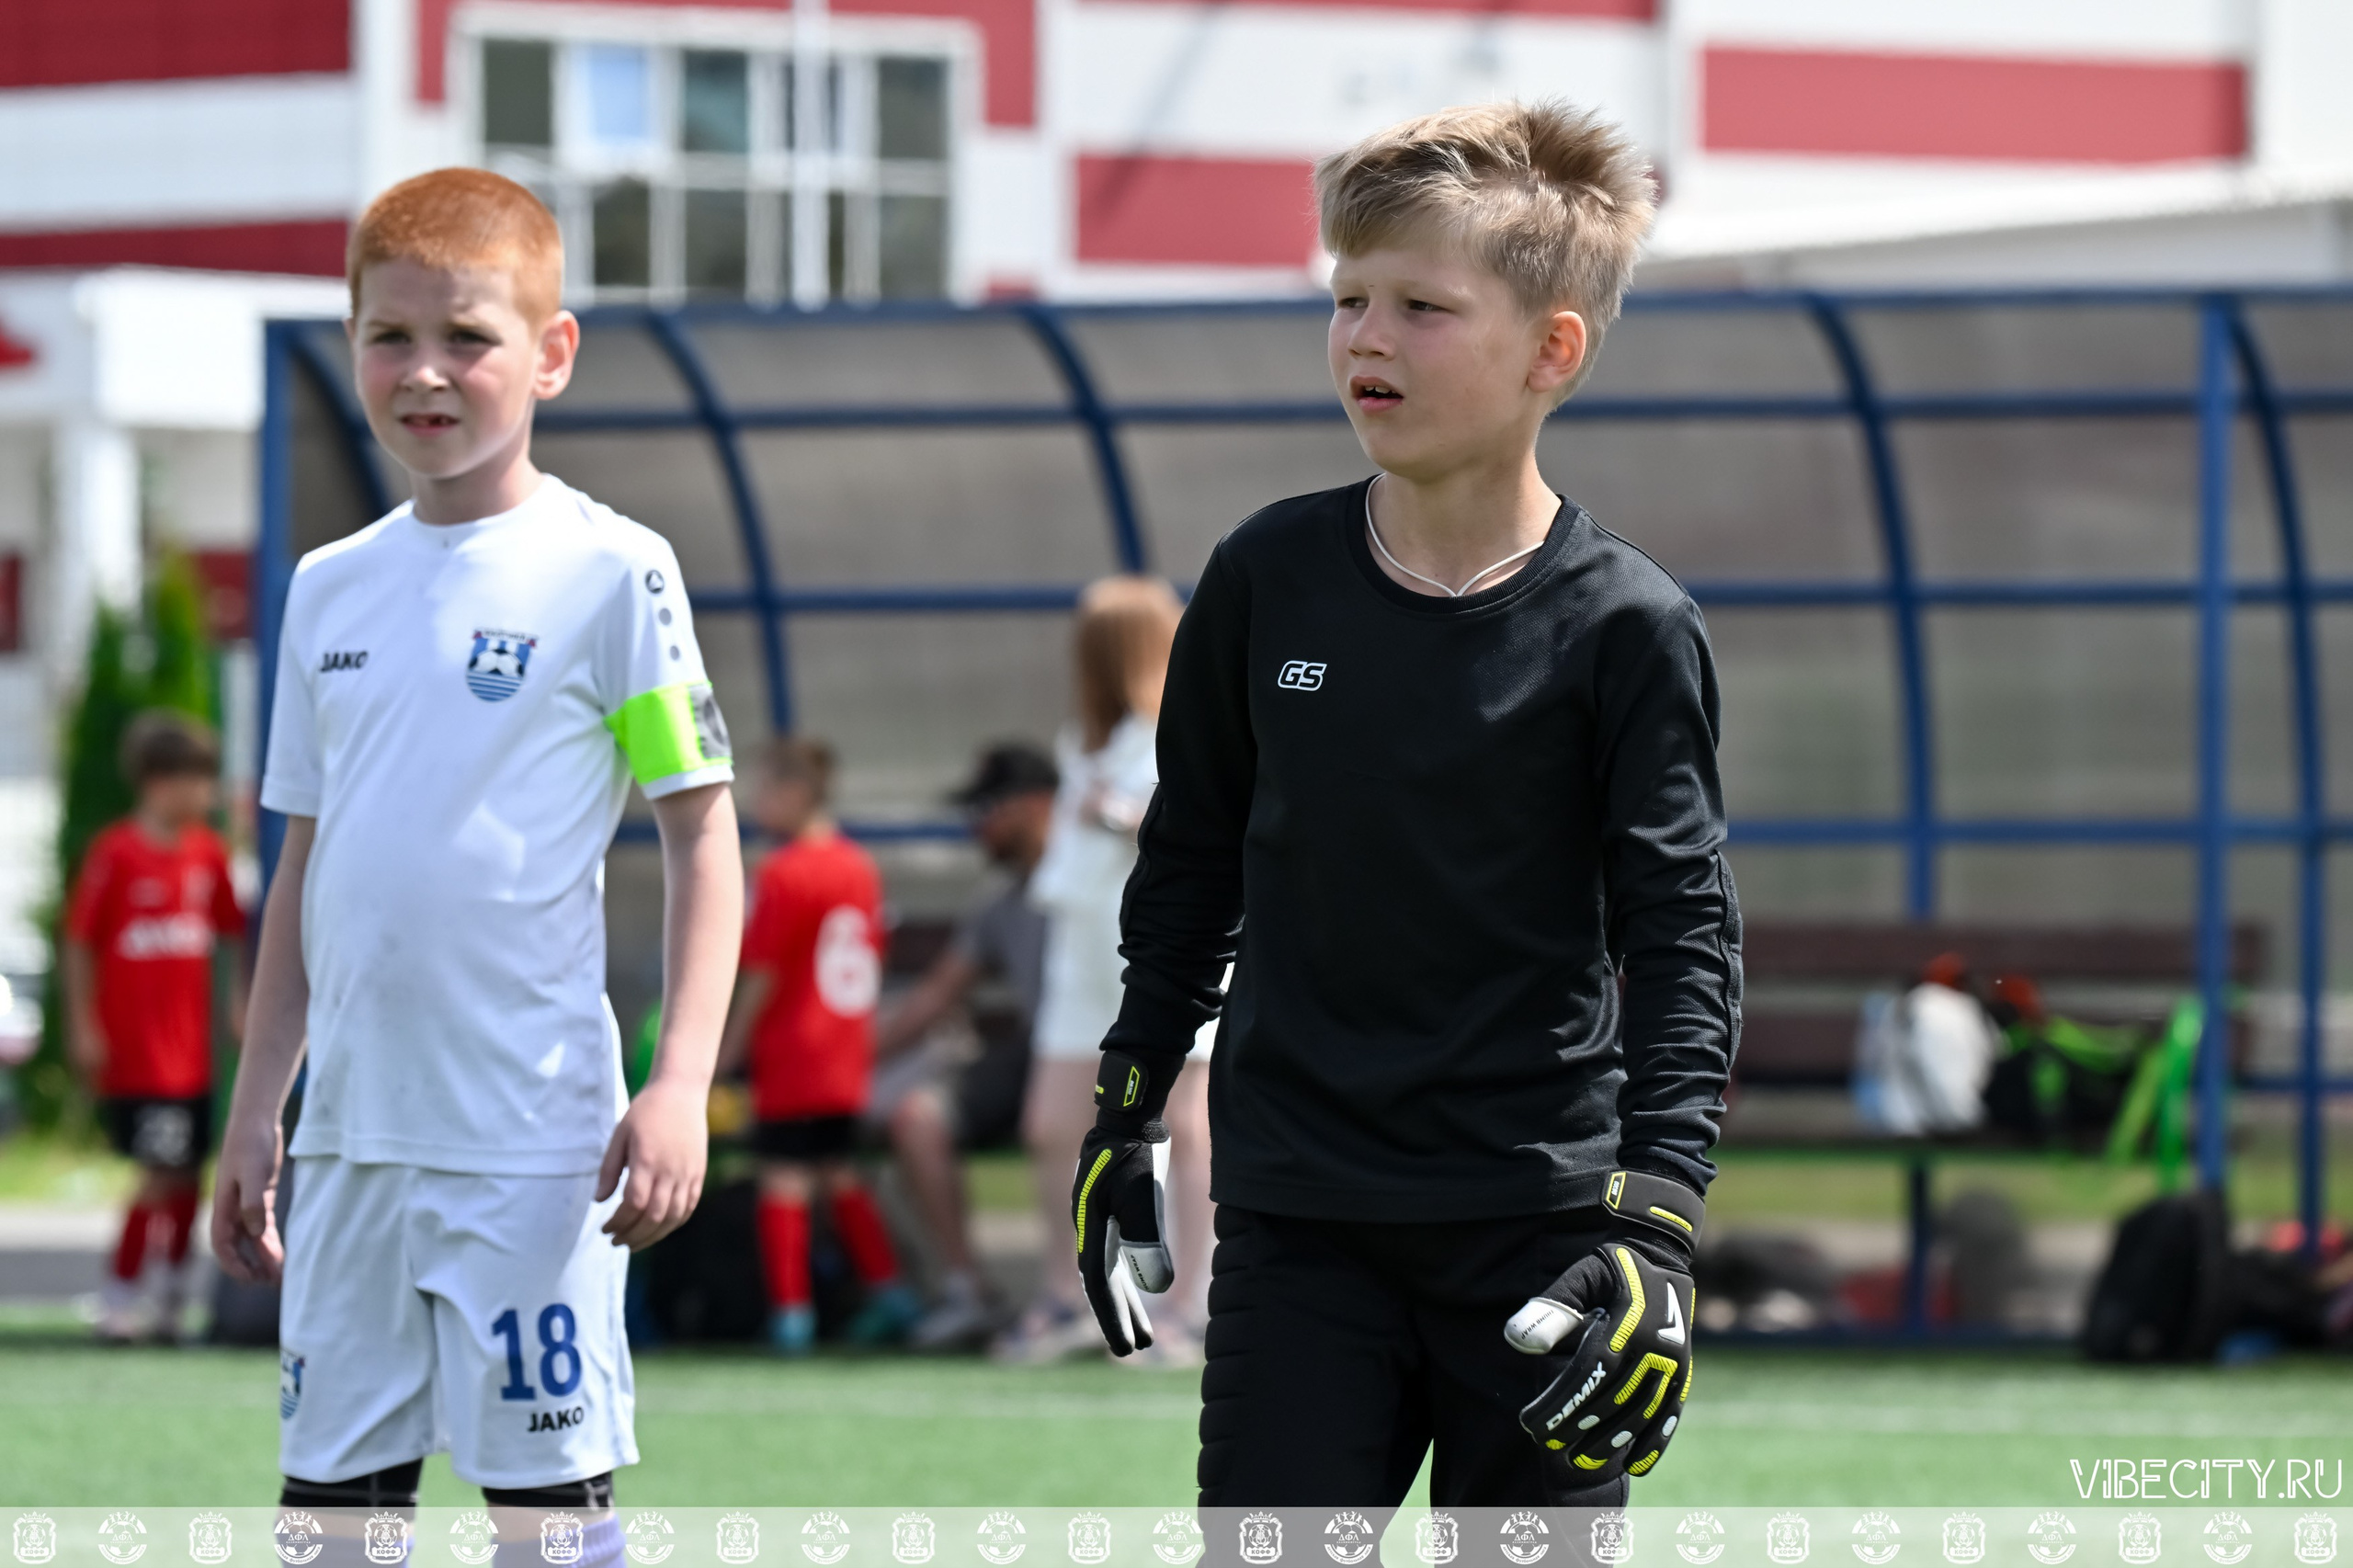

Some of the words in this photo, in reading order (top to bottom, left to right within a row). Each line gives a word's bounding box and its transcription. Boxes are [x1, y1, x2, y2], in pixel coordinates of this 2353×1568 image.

[1278, 660, 1327, 691] GS
[491, 1303, 582, 1401] 18
[527, 1406, 585, 1432] JAKO
[1546, 1361, 1607, 1431] DEMIX
